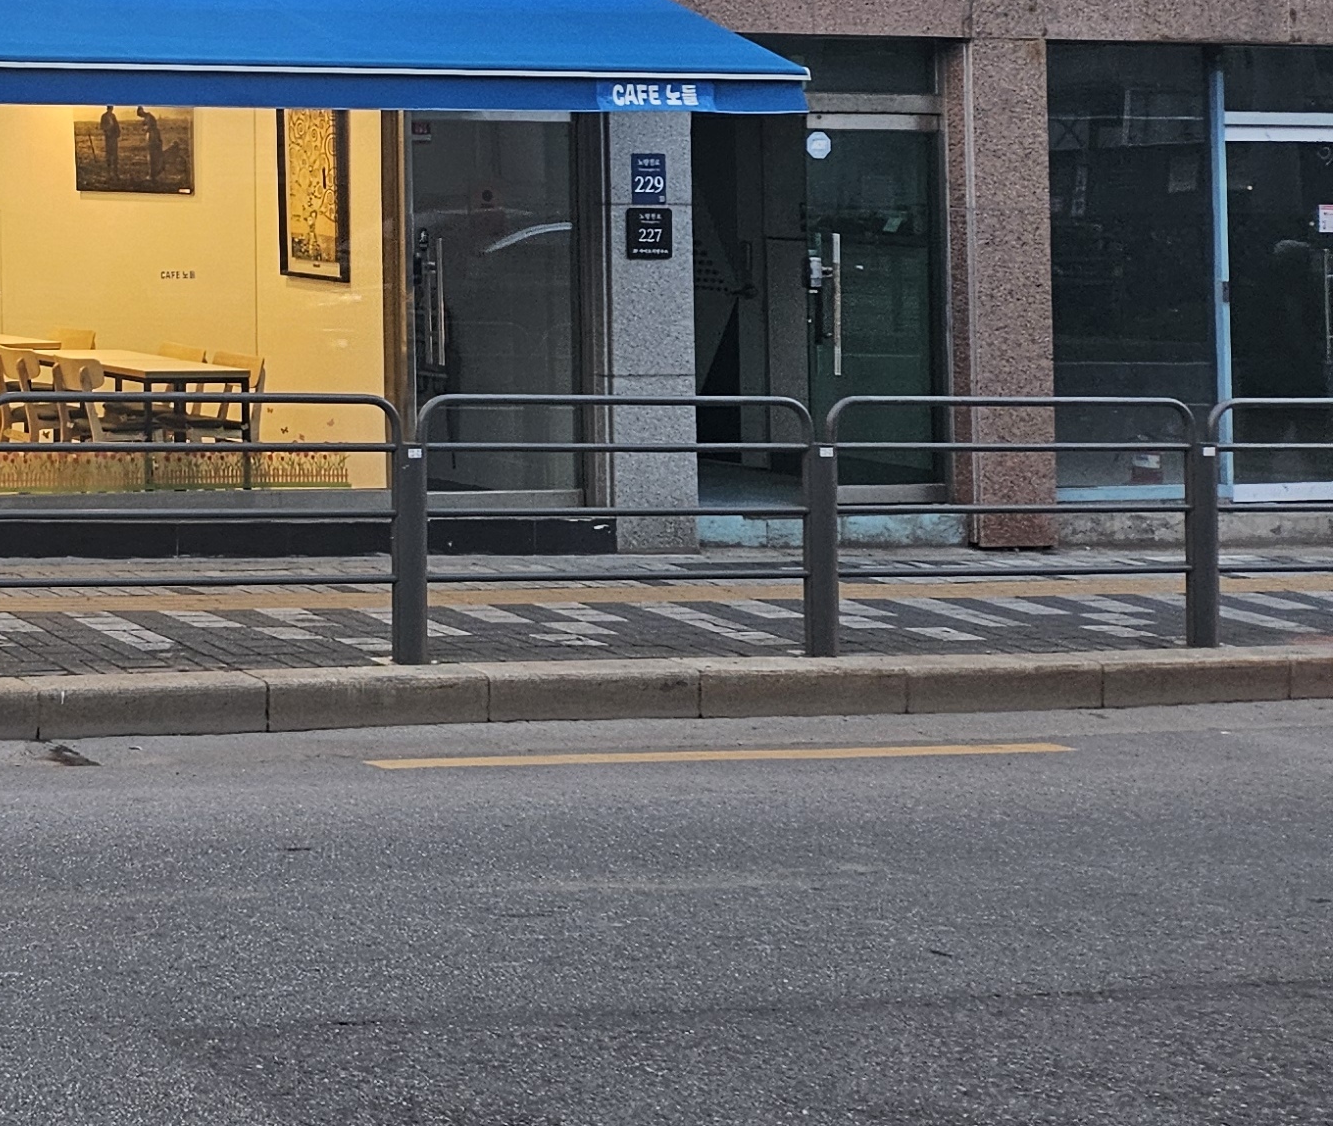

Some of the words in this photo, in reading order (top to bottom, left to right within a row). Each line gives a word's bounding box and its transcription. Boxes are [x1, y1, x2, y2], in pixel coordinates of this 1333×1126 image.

[612, 84, 662, 106] CAFE
[666, 84, 699, 106] 노들
[634, 176, 665, 194] 229
[638, 228, 663, 243] 227
[160, 270, 181, 280] CAFE
